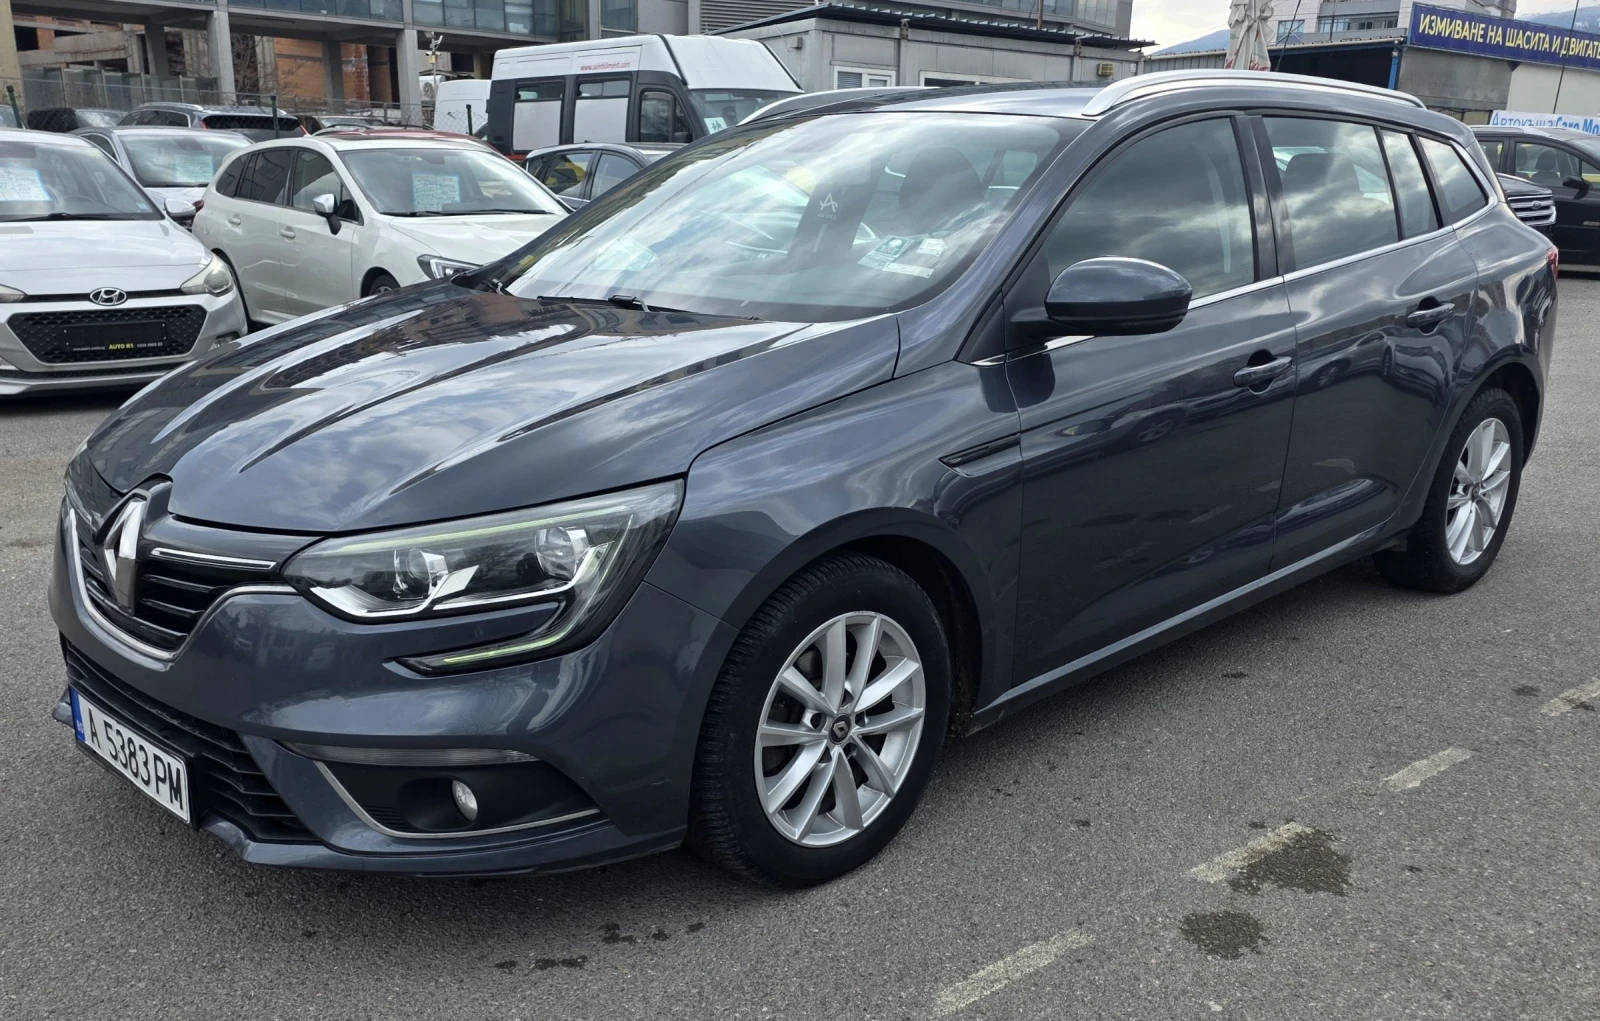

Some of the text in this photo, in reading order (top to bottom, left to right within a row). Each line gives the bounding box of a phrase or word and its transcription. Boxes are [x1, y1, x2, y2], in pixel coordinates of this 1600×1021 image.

[1419, 13, 1486, 43] ИЗМИВАНЕ
[1486, 25, 1503, 46] НА
[1505, 27, 1550, 53] ШАСИТА
[1551, 35, 1561, 53] И
[88, 708, 184, 811] A 5383 PM
